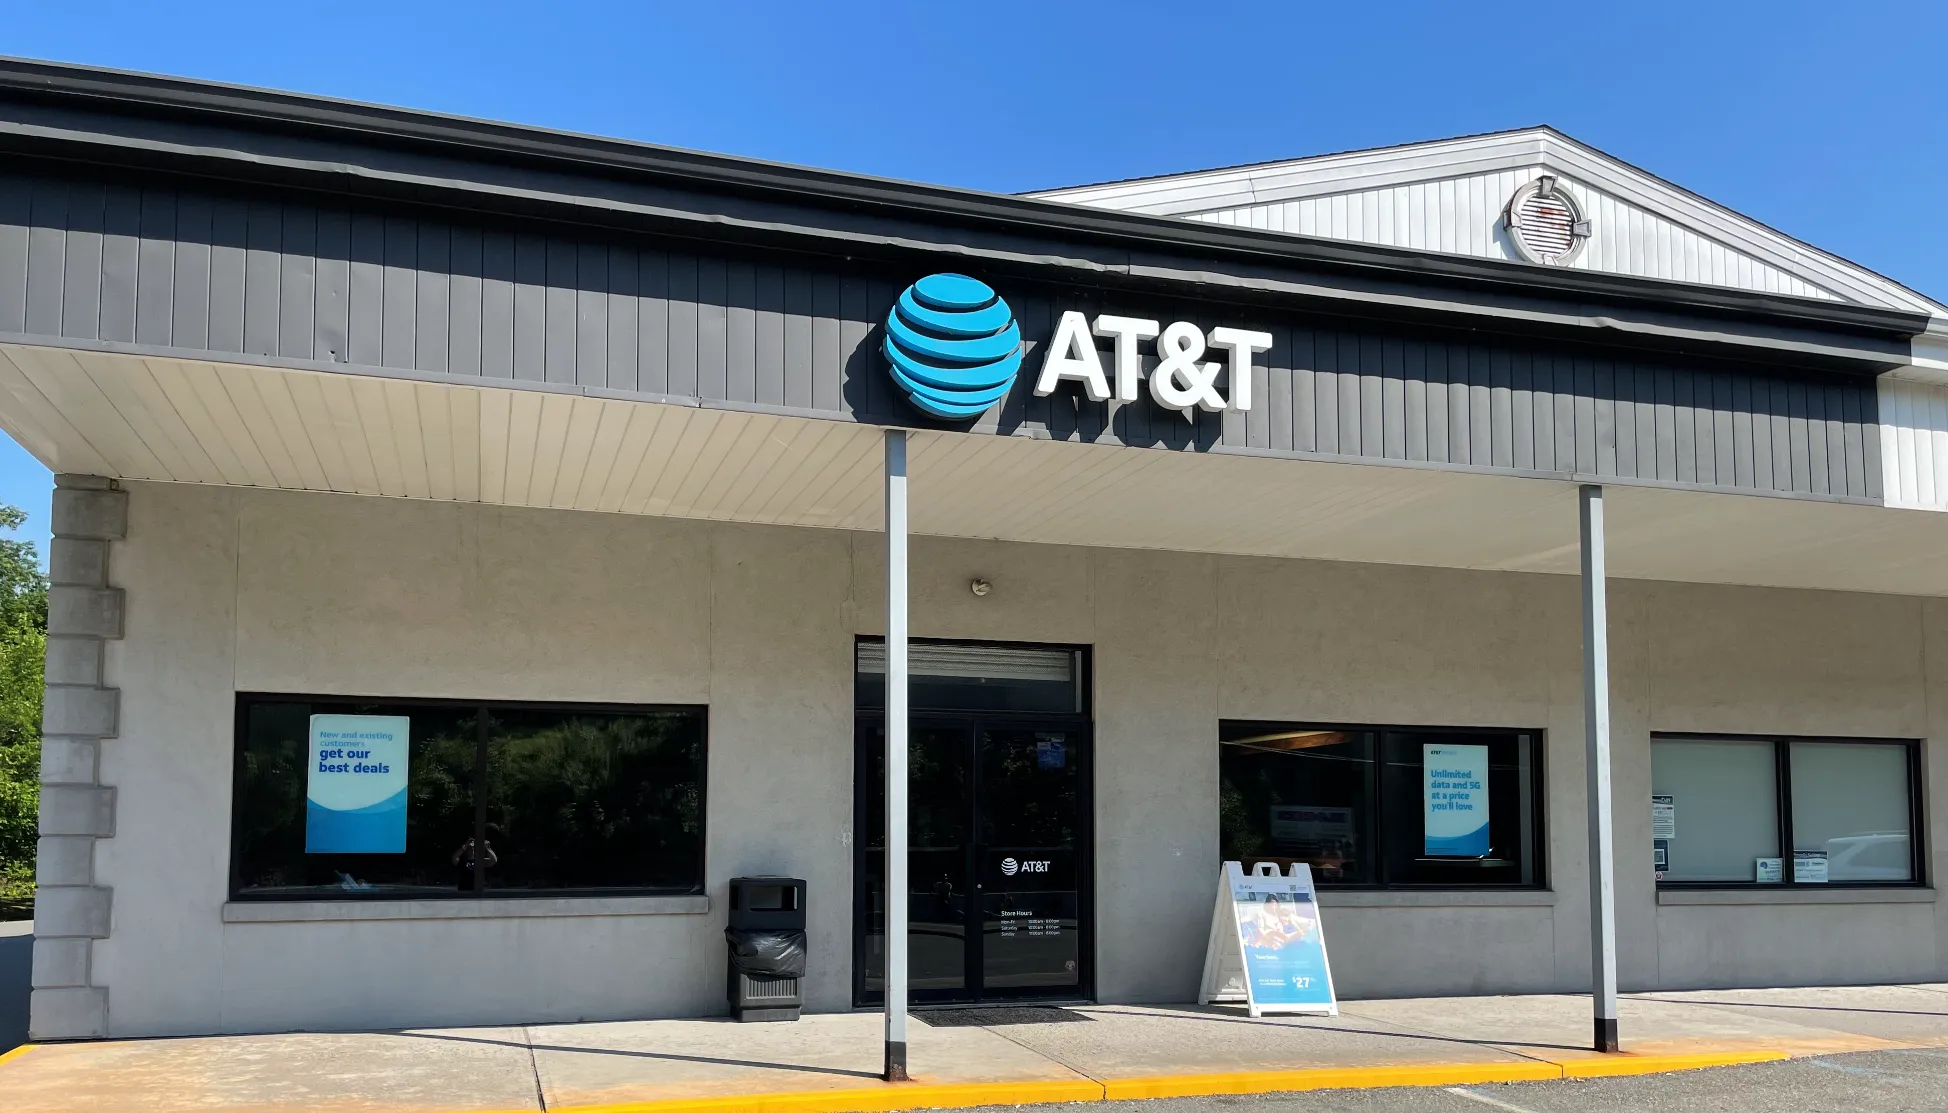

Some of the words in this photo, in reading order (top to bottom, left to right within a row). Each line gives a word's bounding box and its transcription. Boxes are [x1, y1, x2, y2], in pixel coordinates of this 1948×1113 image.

[1034, 311, 1272, 415] AT&T
[359, 732, 393, 741] existing
[320, 740, 365, 748] customers
[319, 749, 344, 761] get
[347, 750, 370, 759] our
[319, 762, 350, 773] best
[353, 762, 390, 774] deals
[1431, 769, 1472, 778] Unlimited
[1431, 780, 1450, 789] data
[1452, 781, 1467, 789] and
[1470, 781, 1481, 789] 5G
[1431, 792, 1441, 800] at
[1449, 791, 1470, 801] price
[1431, 801, 1454, 812] you'll
[1455, 801, 1473, 810] love
[1021, 860, 1051, 872] AT&T
[1292, 976, 1310, 988] $27
